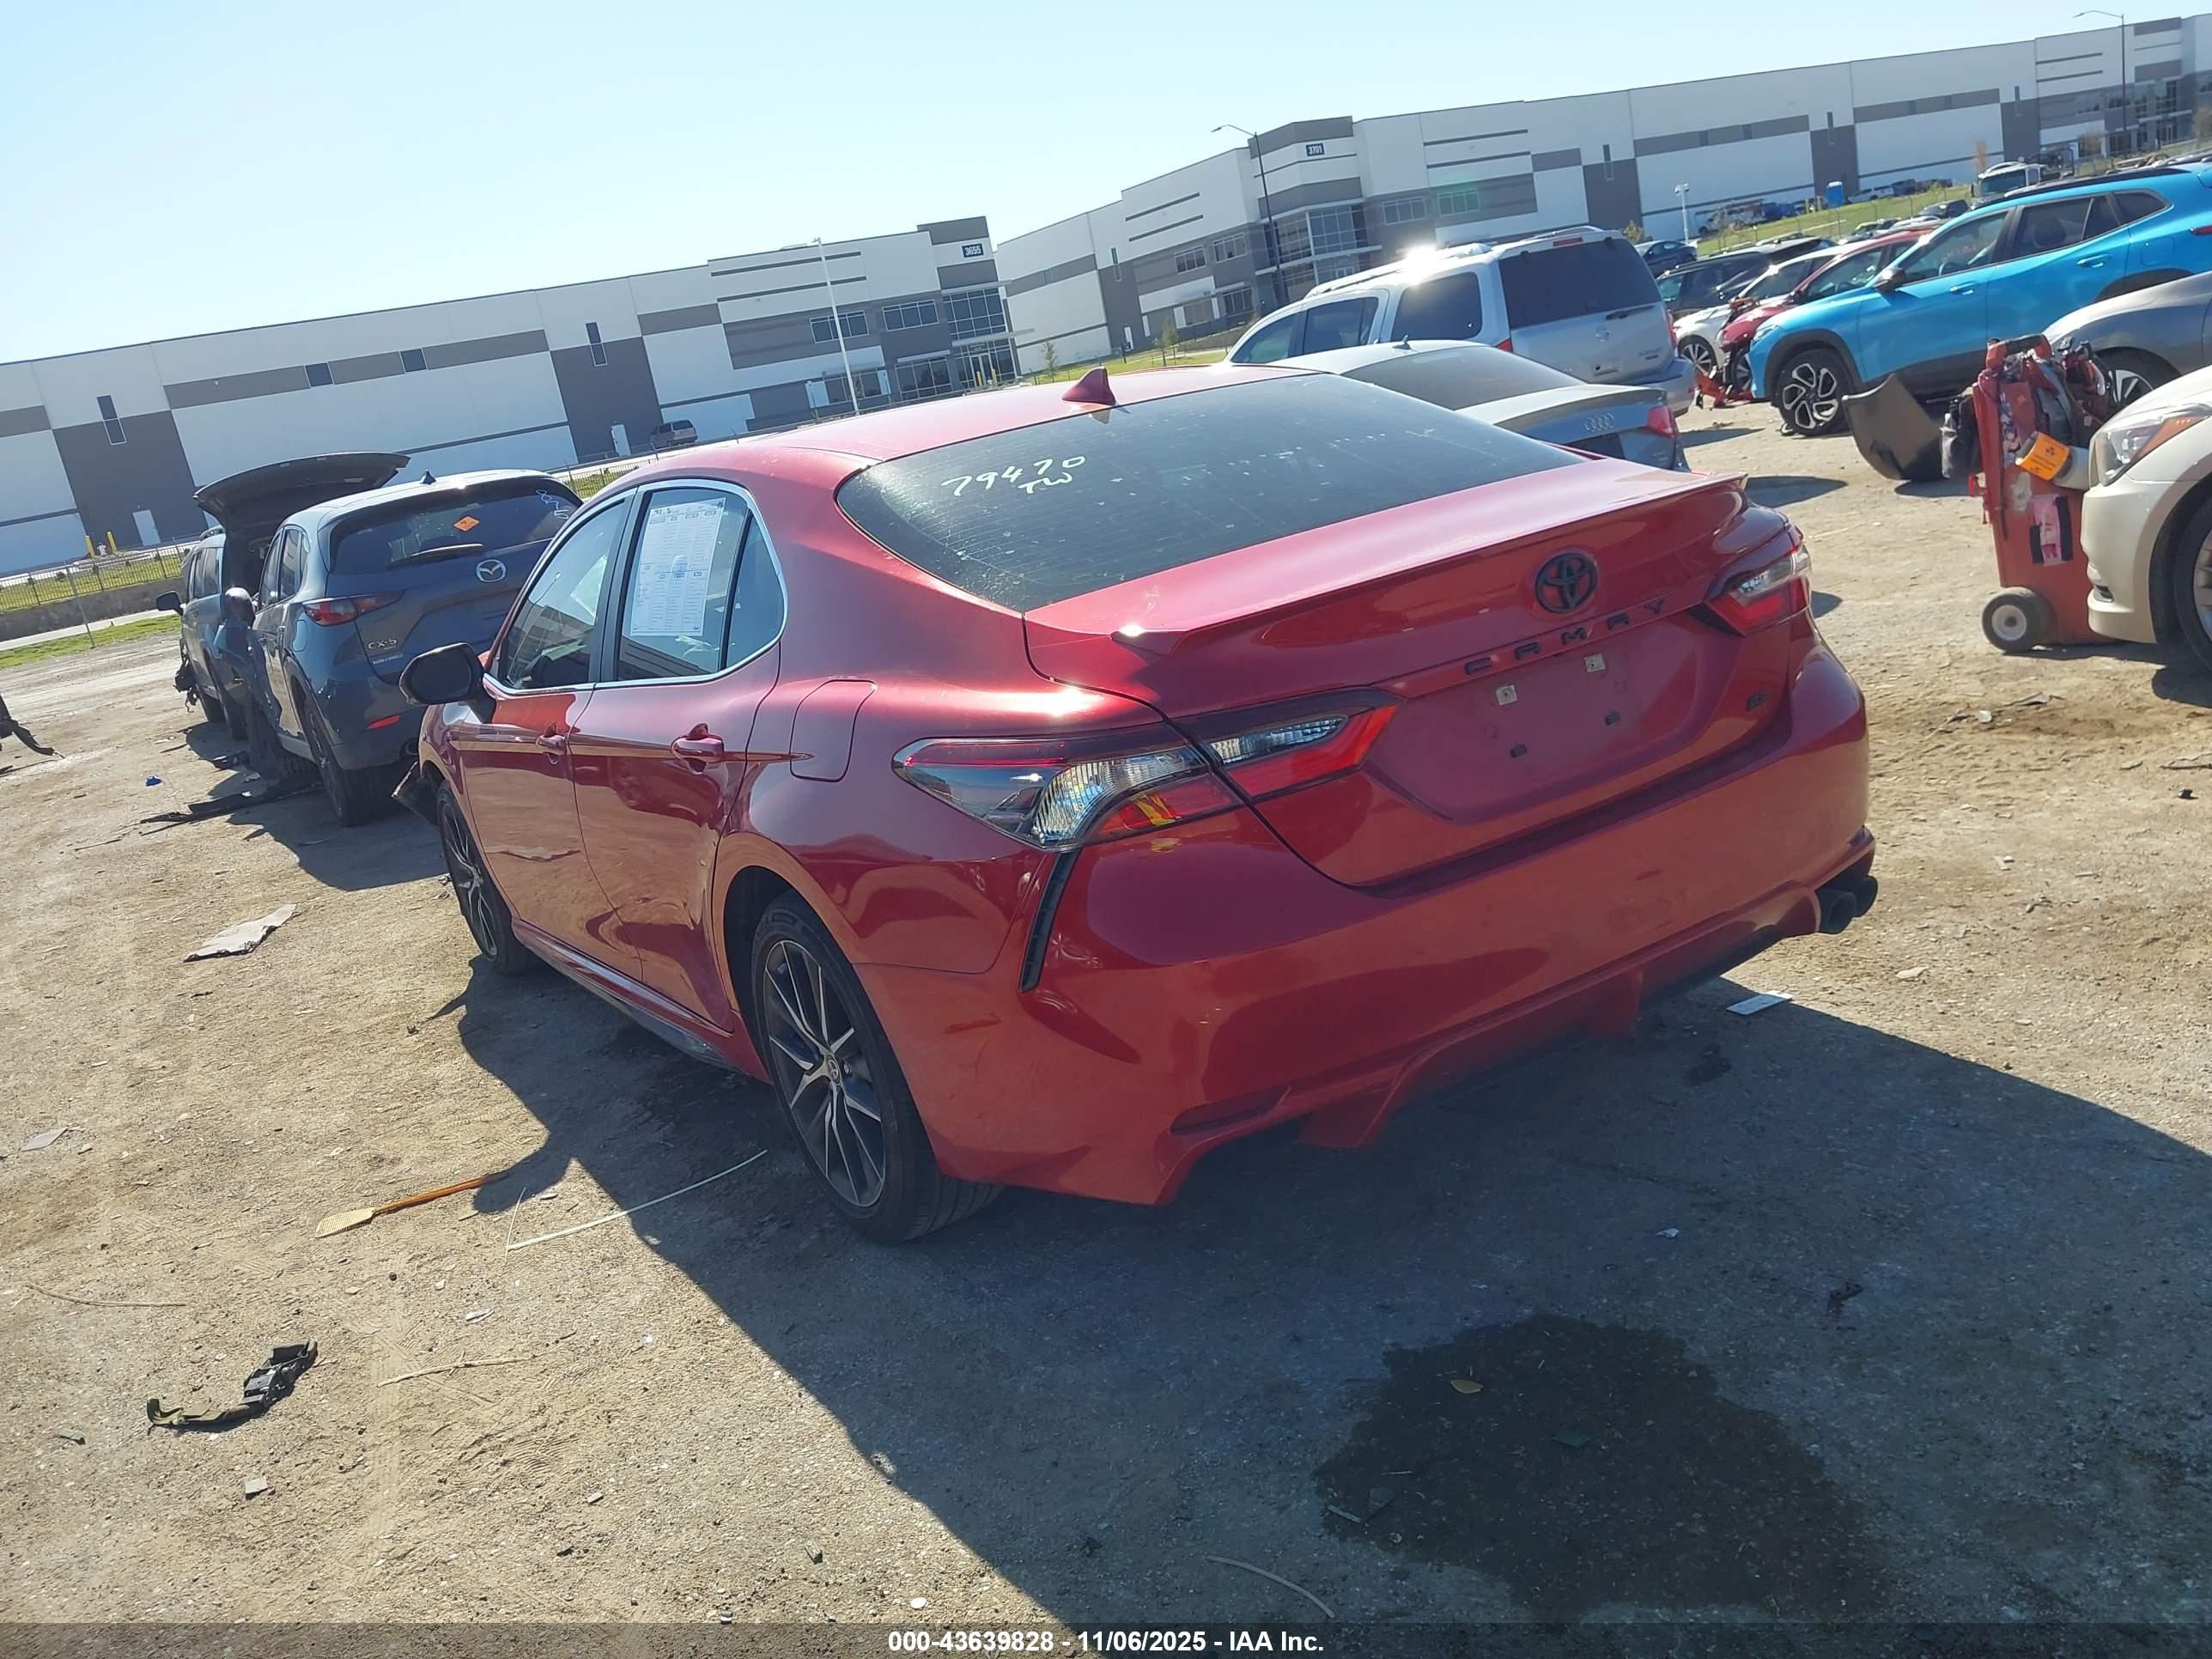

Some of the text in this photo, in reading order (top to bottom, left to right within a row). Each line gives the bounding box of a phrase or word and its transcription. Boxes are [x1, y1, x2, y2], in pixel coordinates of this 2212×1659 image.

[963, 245, 982, 257] 3655
[940, 456, 1086, 496] 79470
[368, 639, 398, 650] CX-5
[1464, 599, 1664, 675] CAMRY
